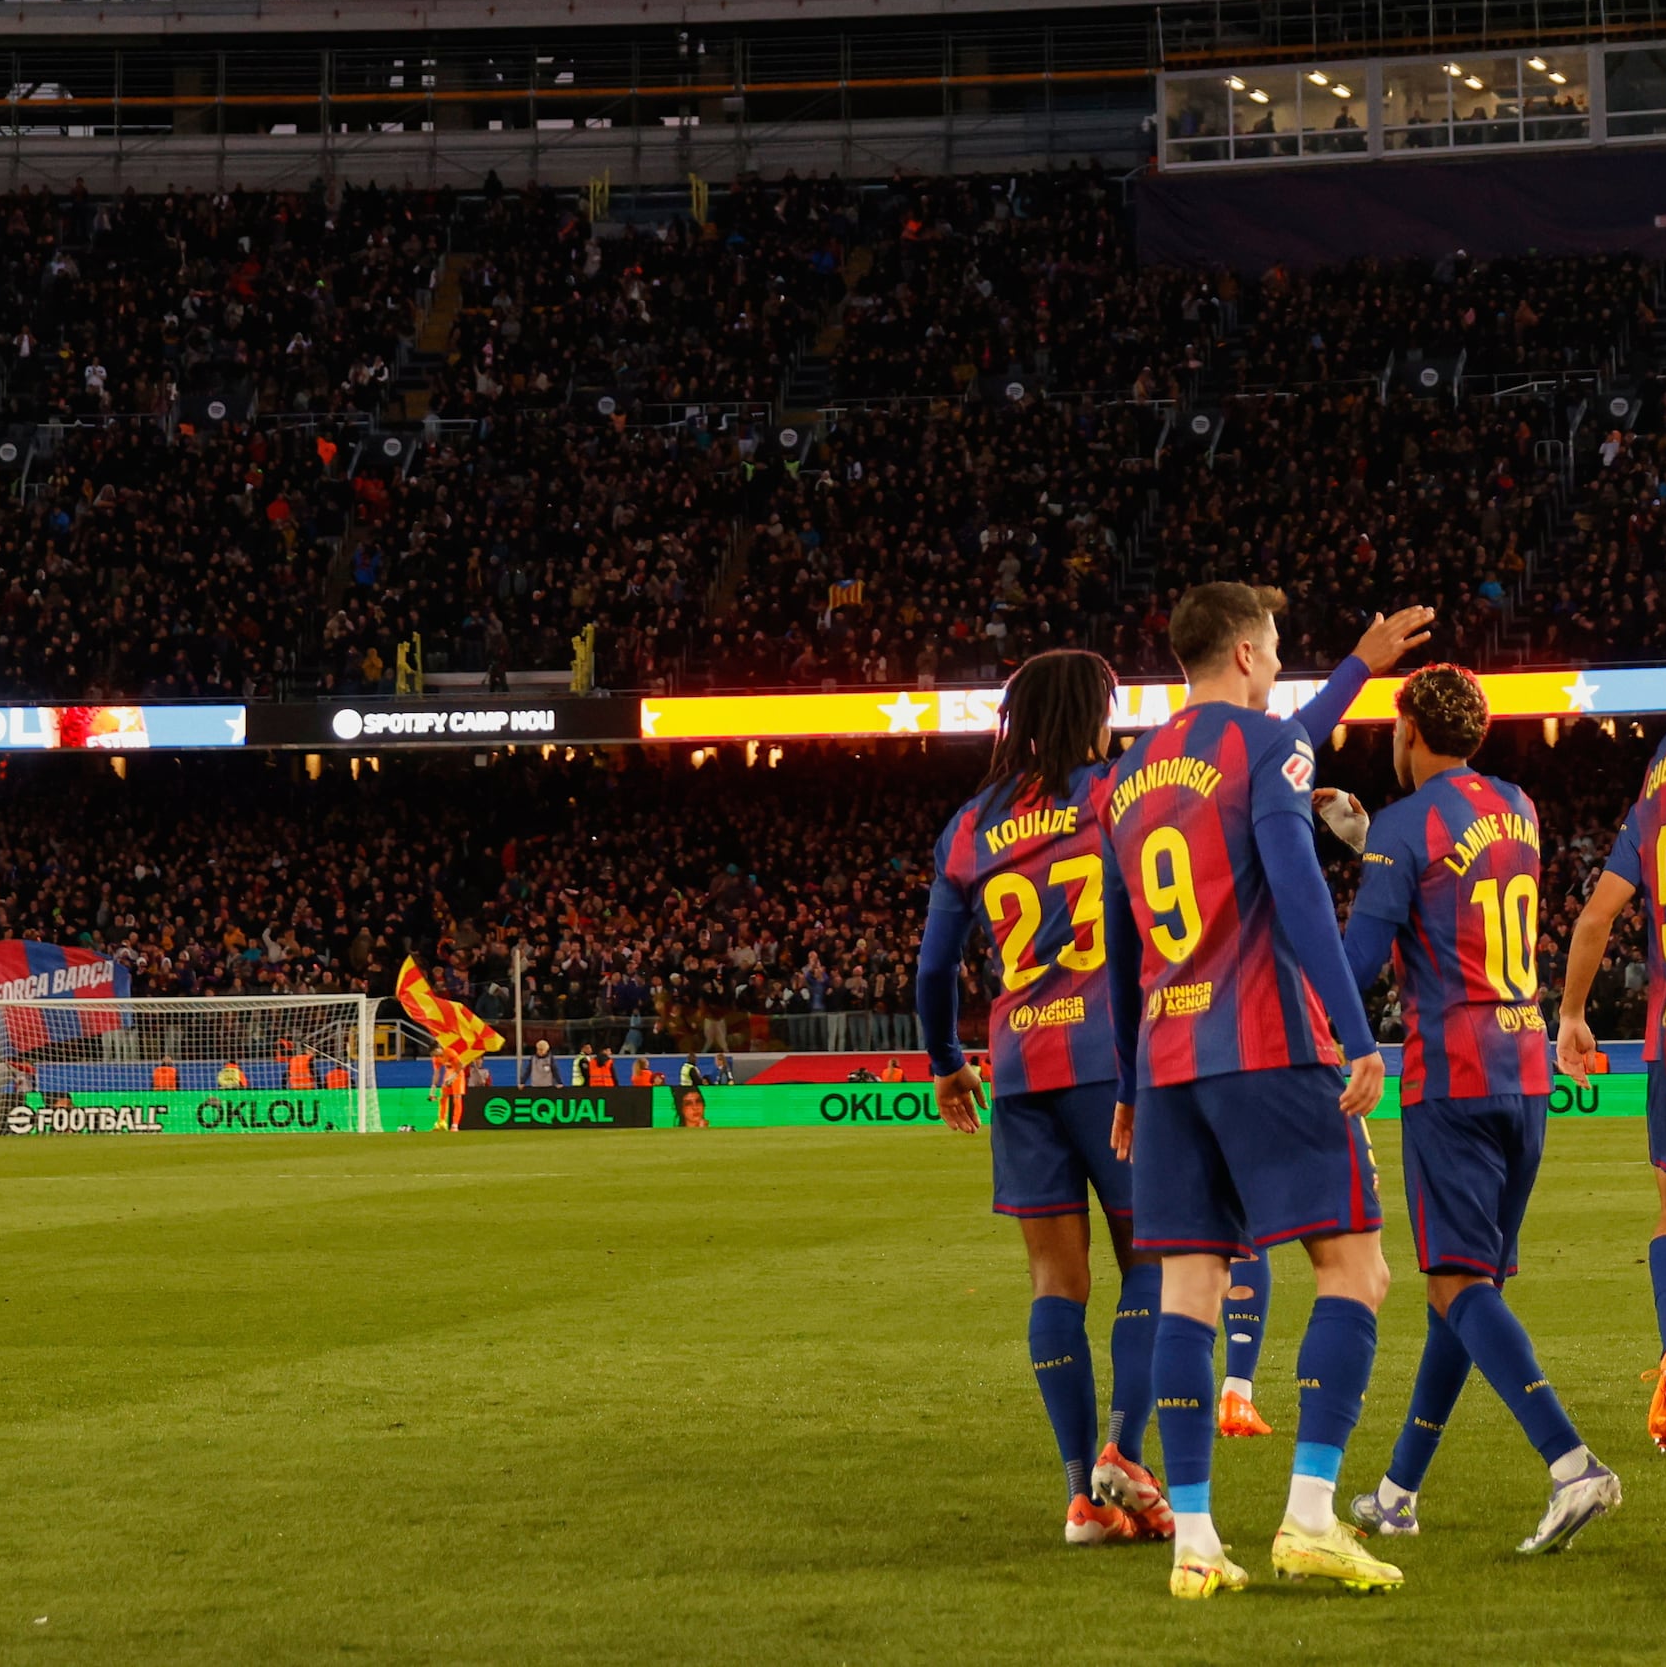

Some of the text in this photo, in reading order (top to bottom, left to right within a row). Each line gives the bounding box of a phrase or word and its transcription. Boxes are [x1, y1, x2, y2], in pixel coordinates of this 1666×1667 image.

[363, 710, 555, 733] SPOTIFY CAMP NOU
[1110, 756, 1222, 825] LEWANDOWSKI
[1443, 814, 1502, 876] LAMINE
[1141, 826, 1202, 964] 9
[984, 853, 1106, 992] 23
[1470, 874, 1538, 1000] 10
[1163, 981, 1212, 999] UNHCR
[1165, 993, 1211, 1011] ACNUR
[1038, 1007, 1085, 1021] ACNUR
[197, 1099, 320, 1128] OKLOU
[514, 1098, 614, 1124] EQUAL
